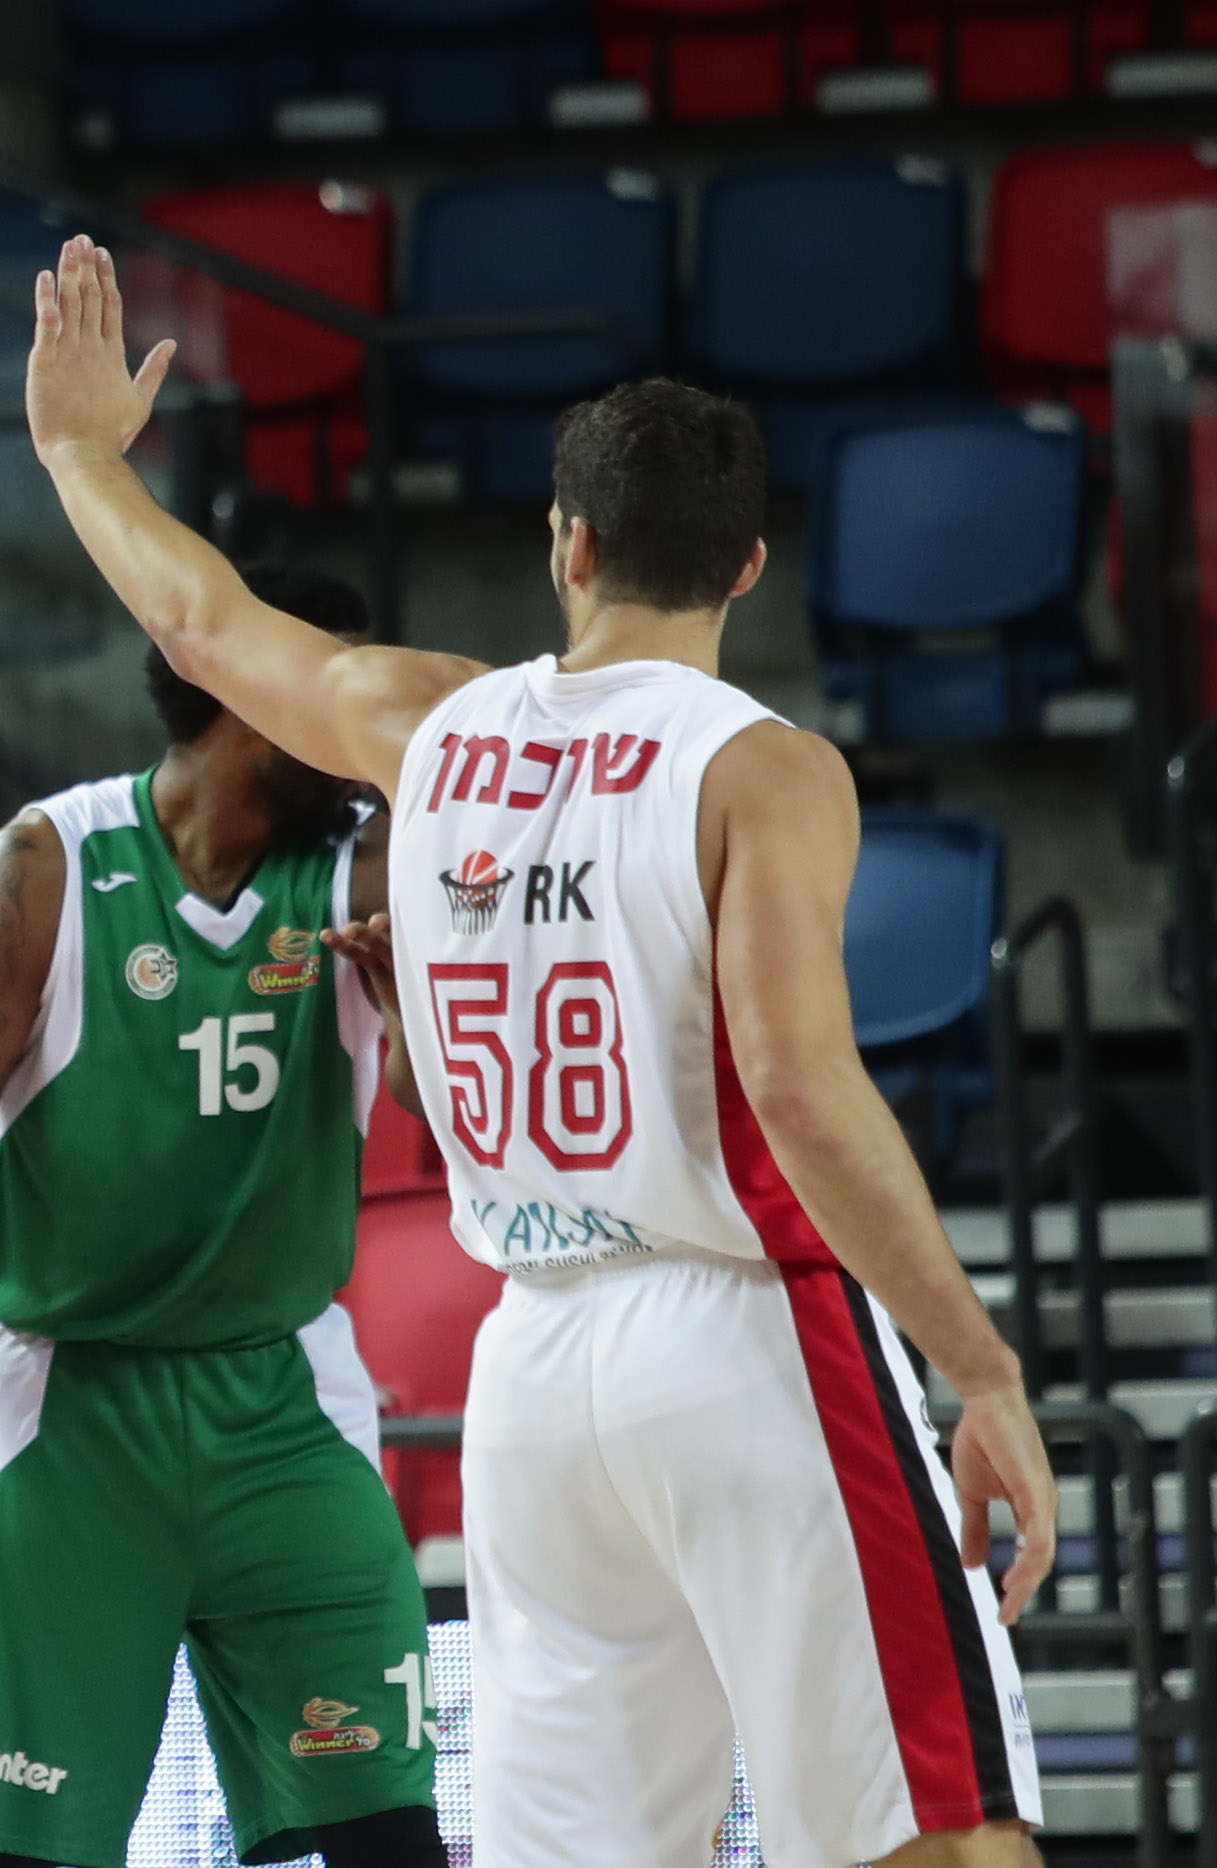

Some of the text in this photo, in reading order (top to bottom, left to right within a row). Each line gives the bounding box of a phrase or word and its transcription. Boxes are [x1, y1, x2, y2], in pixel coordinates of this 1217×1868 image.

[427, 731, 661, 813] שוכמן
[523, 860, 597, 926] RK
[178, 1013, 281, 1117] 15
[427, 961, 633, 1172] 58
[297, 1735, 355, 1752] Winner
